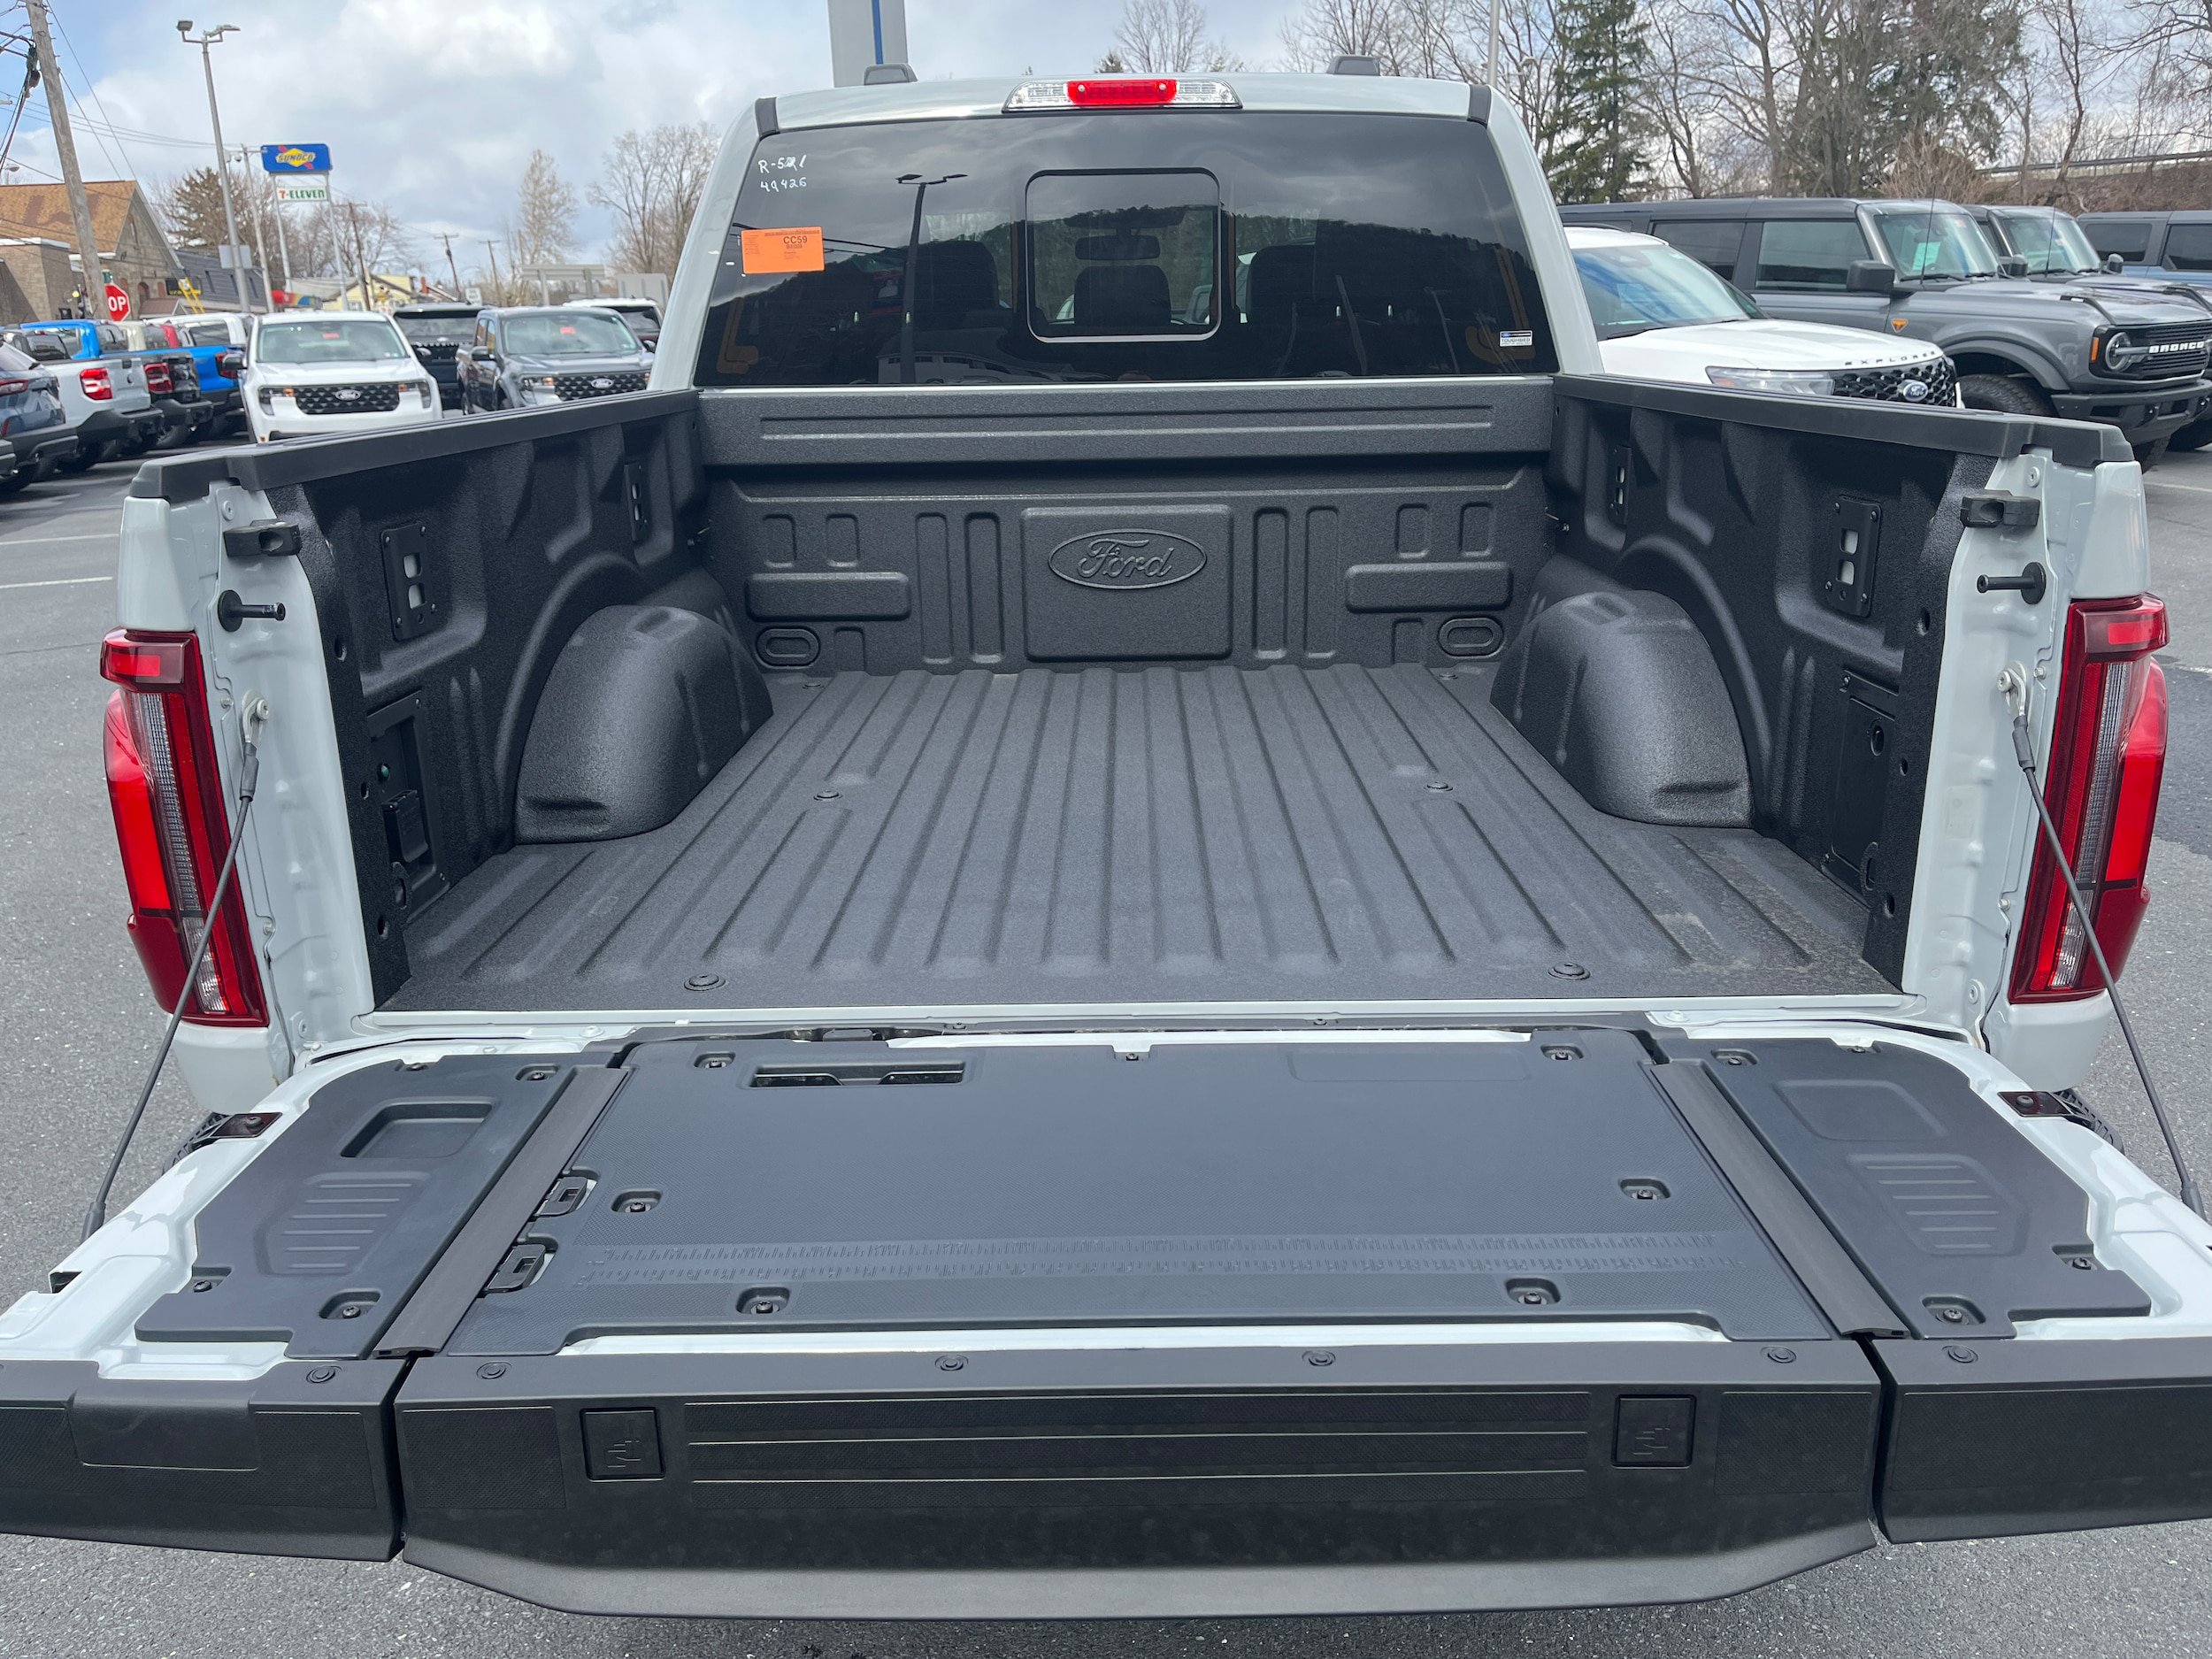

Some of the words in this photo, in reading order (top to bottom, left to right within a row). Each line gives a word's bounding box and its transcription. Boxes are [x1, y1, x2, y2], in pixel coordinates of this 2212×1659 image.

[276, 153, 315, 163] SUNOCO
[783, 235, 808, 244] CC59
[108, 296, 127, 312] OP
[2148, 341, 2206, 354] BRONCO
[1845, 351, 1936, 366] EXPLORER
[1078, 538, 1174, 578] Ford
